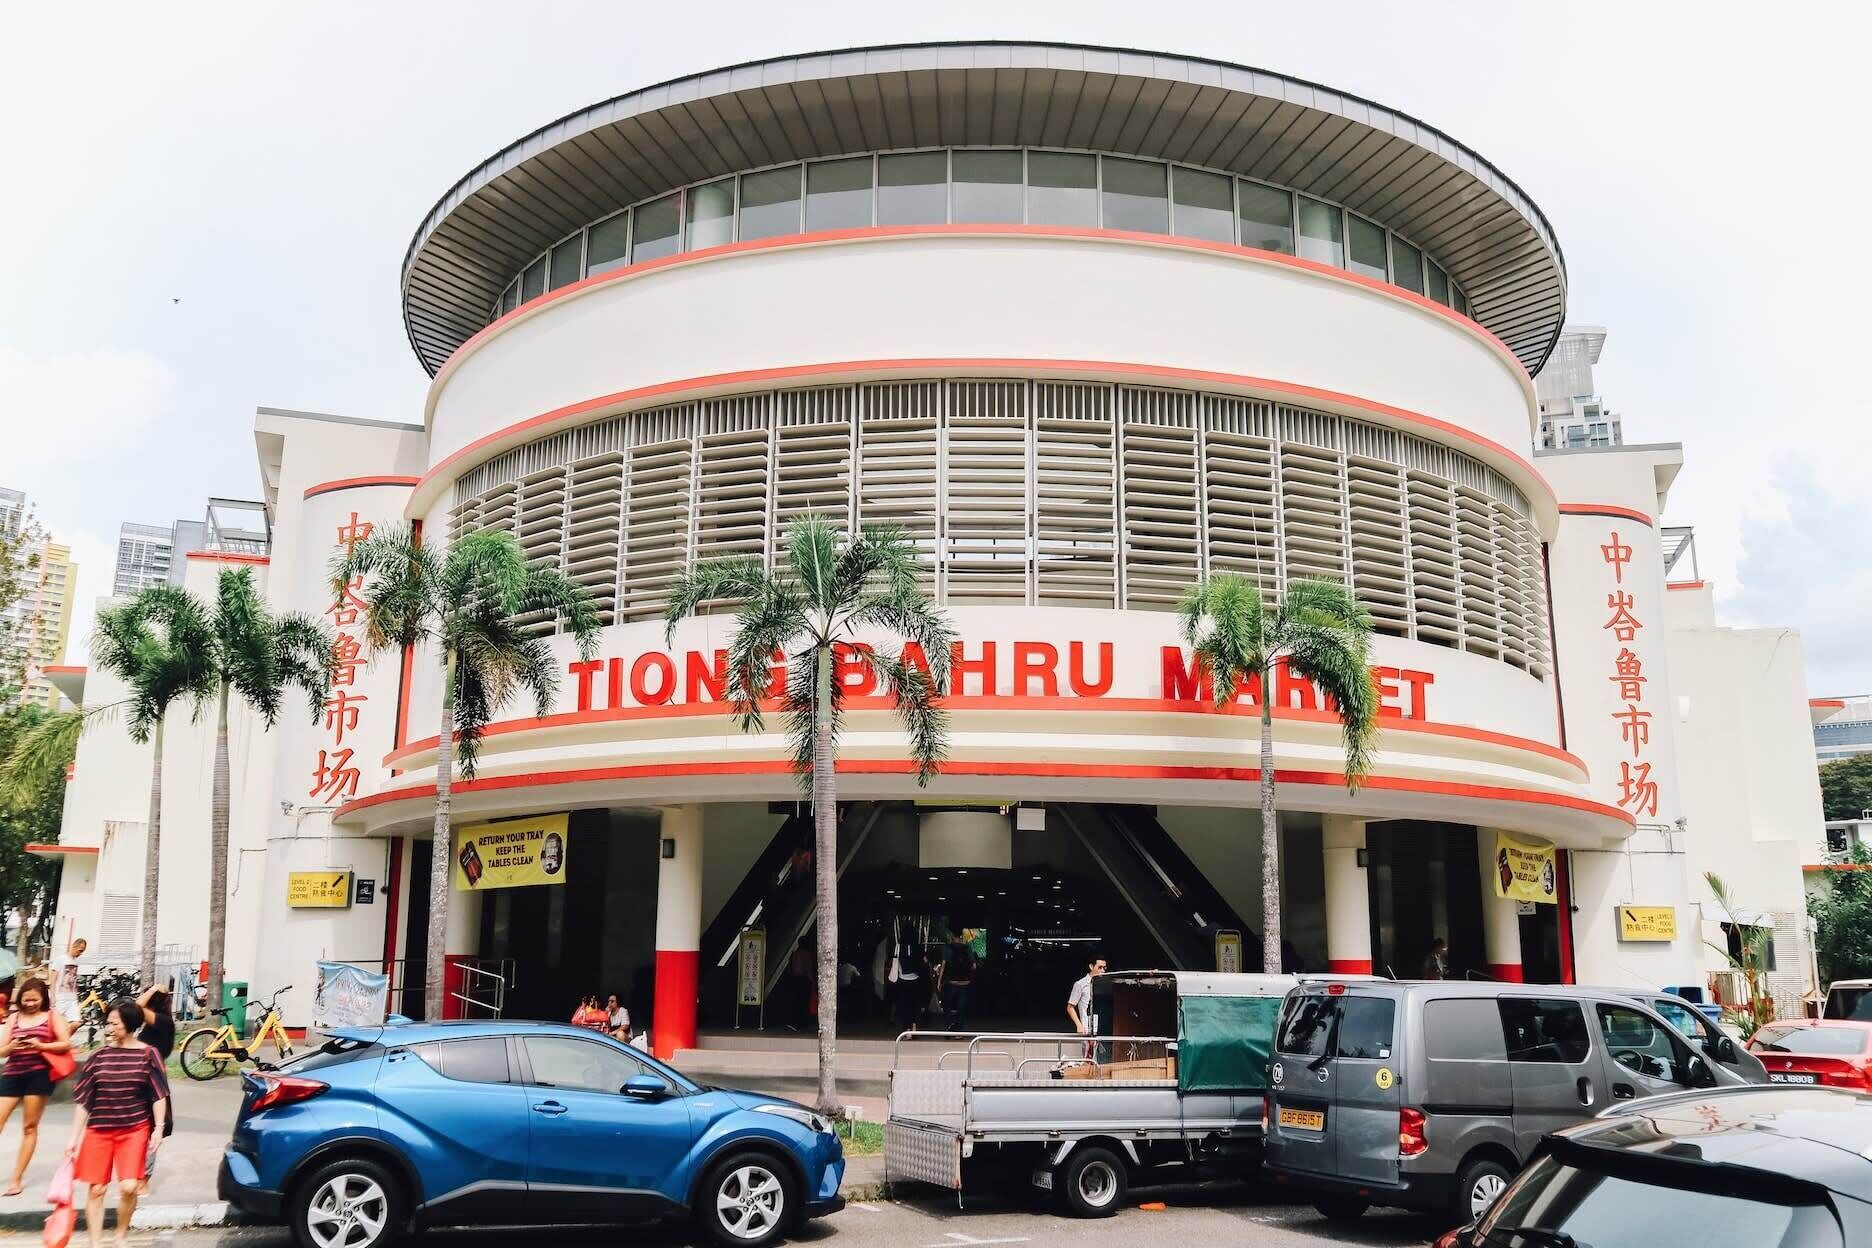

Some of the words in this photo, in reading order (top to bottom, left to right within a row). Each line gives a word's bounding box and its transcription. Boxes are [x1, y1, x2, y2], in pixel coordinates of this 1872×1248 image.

[830, 640, 1114, 698] BAHRU
[1160, 645, 1434, 722] MARET
[1600, 531, 1659, 818] 中峇鲁市场
[479, 834, 505, 846] RETURN
[506, 832, 525, 843] YOUR
[526, 830, 544, 841] TRAY
[495, 846, 512, 856] KEEP
[513, 844, 526, 854] THE
[488, 858, 512, 869] TABLES
[512, 856, 534, 866] CLEAN
[1381, 1072, 1388, 1081] 6
